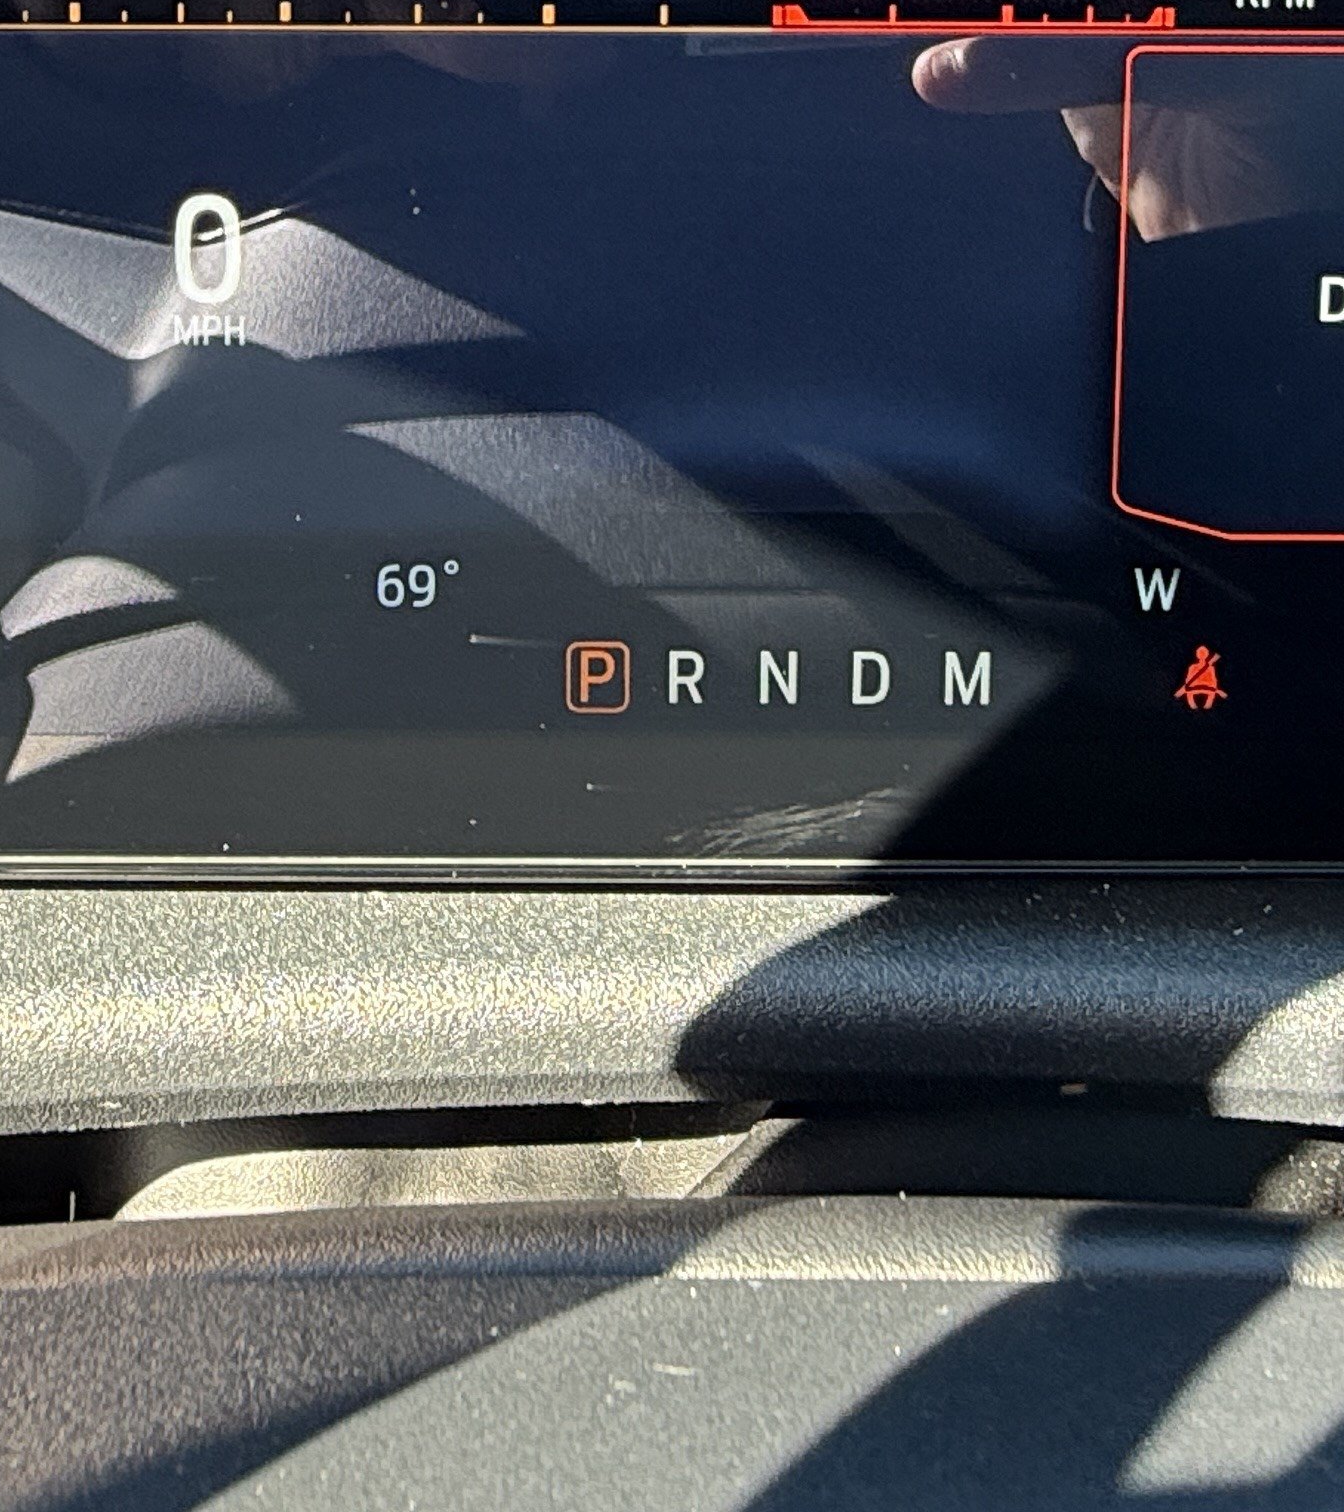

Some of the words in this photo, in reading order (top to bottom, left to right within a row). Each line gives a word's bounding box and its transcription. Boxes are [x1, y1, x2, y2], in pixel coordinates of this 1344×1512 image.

[174, 193, 241, 305] 0
[172, 314, 247, 346] MPH
[1134, 567, 1180, 612] W
[578, 650, 616, 703] P
[668, 650, 705, 705] R
[759, 651, 798, 705] N
[851, 651, 890, 705] D
[944, 652, 991, 706] M
